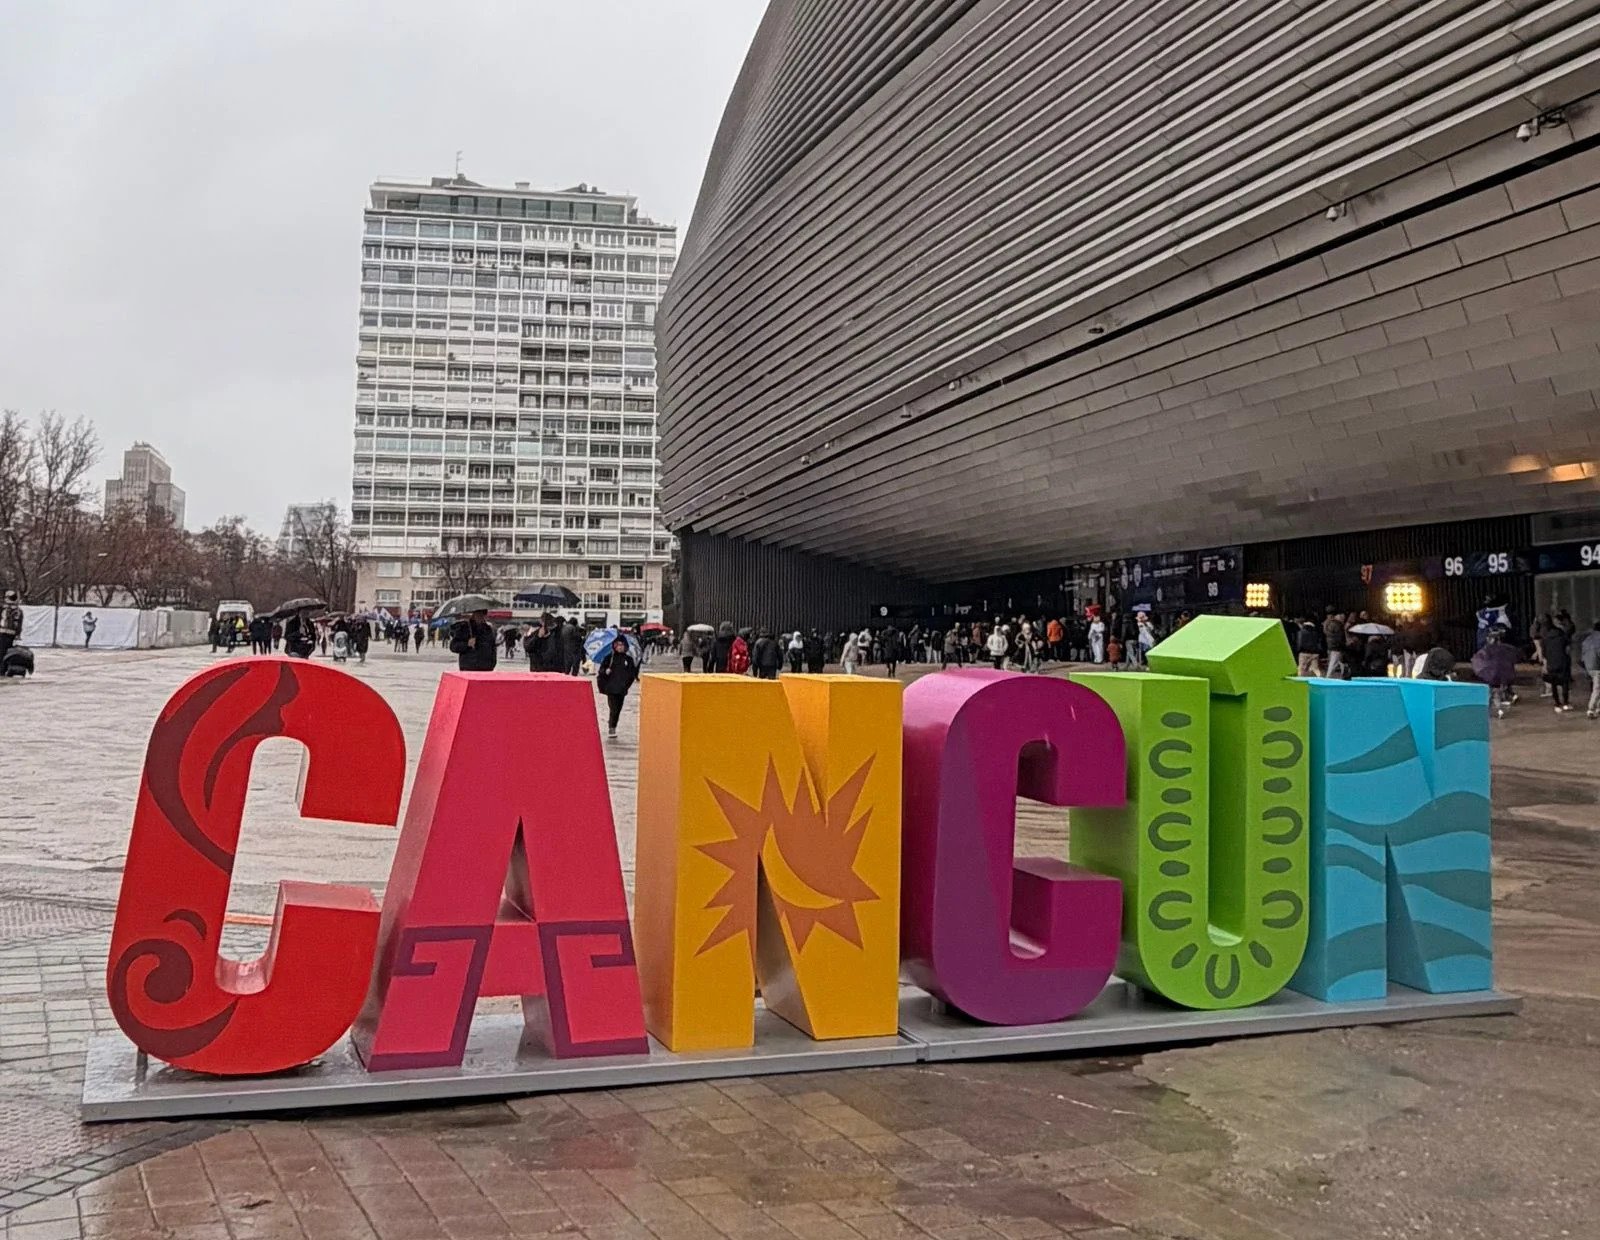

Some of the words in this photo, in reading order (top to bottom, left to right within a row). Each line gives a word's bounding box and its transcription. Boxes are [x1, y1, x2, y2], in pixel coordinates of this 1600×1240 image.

[1488, 553, 1508, 573] 95
[1580, 544, 1600, 566] 94
[1445, 557, 1463, 576] 96
[107, 615, 1492, 1076] CANCÚN
